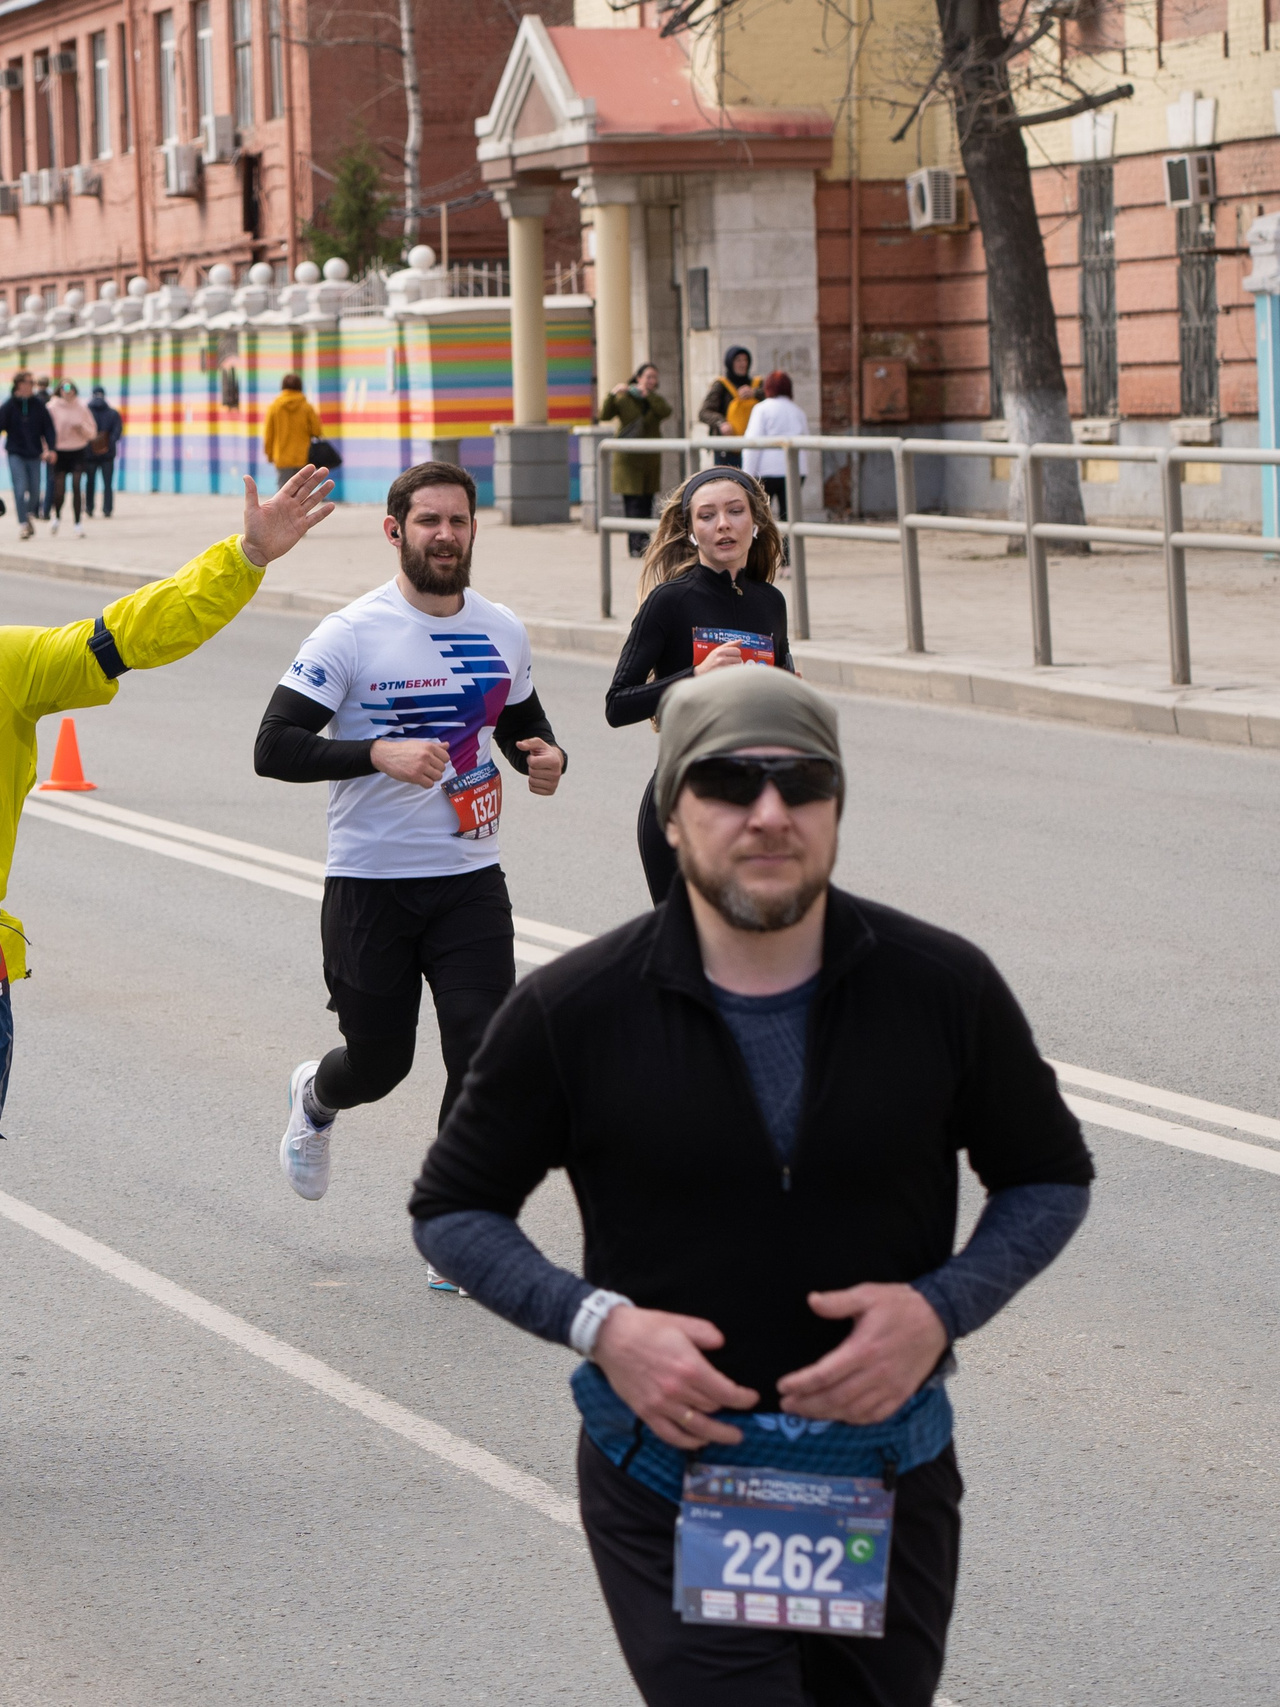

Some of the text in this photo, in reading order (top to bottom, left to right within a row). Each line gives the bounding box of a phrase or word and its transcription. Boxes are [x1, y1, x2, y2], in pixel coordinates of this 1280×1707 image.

[369, 678, 448, 692] #ЭТМБЕЖИТ
[471, 789, 497, 825] 1327
[721, 1529, 846, 1593] 2262
